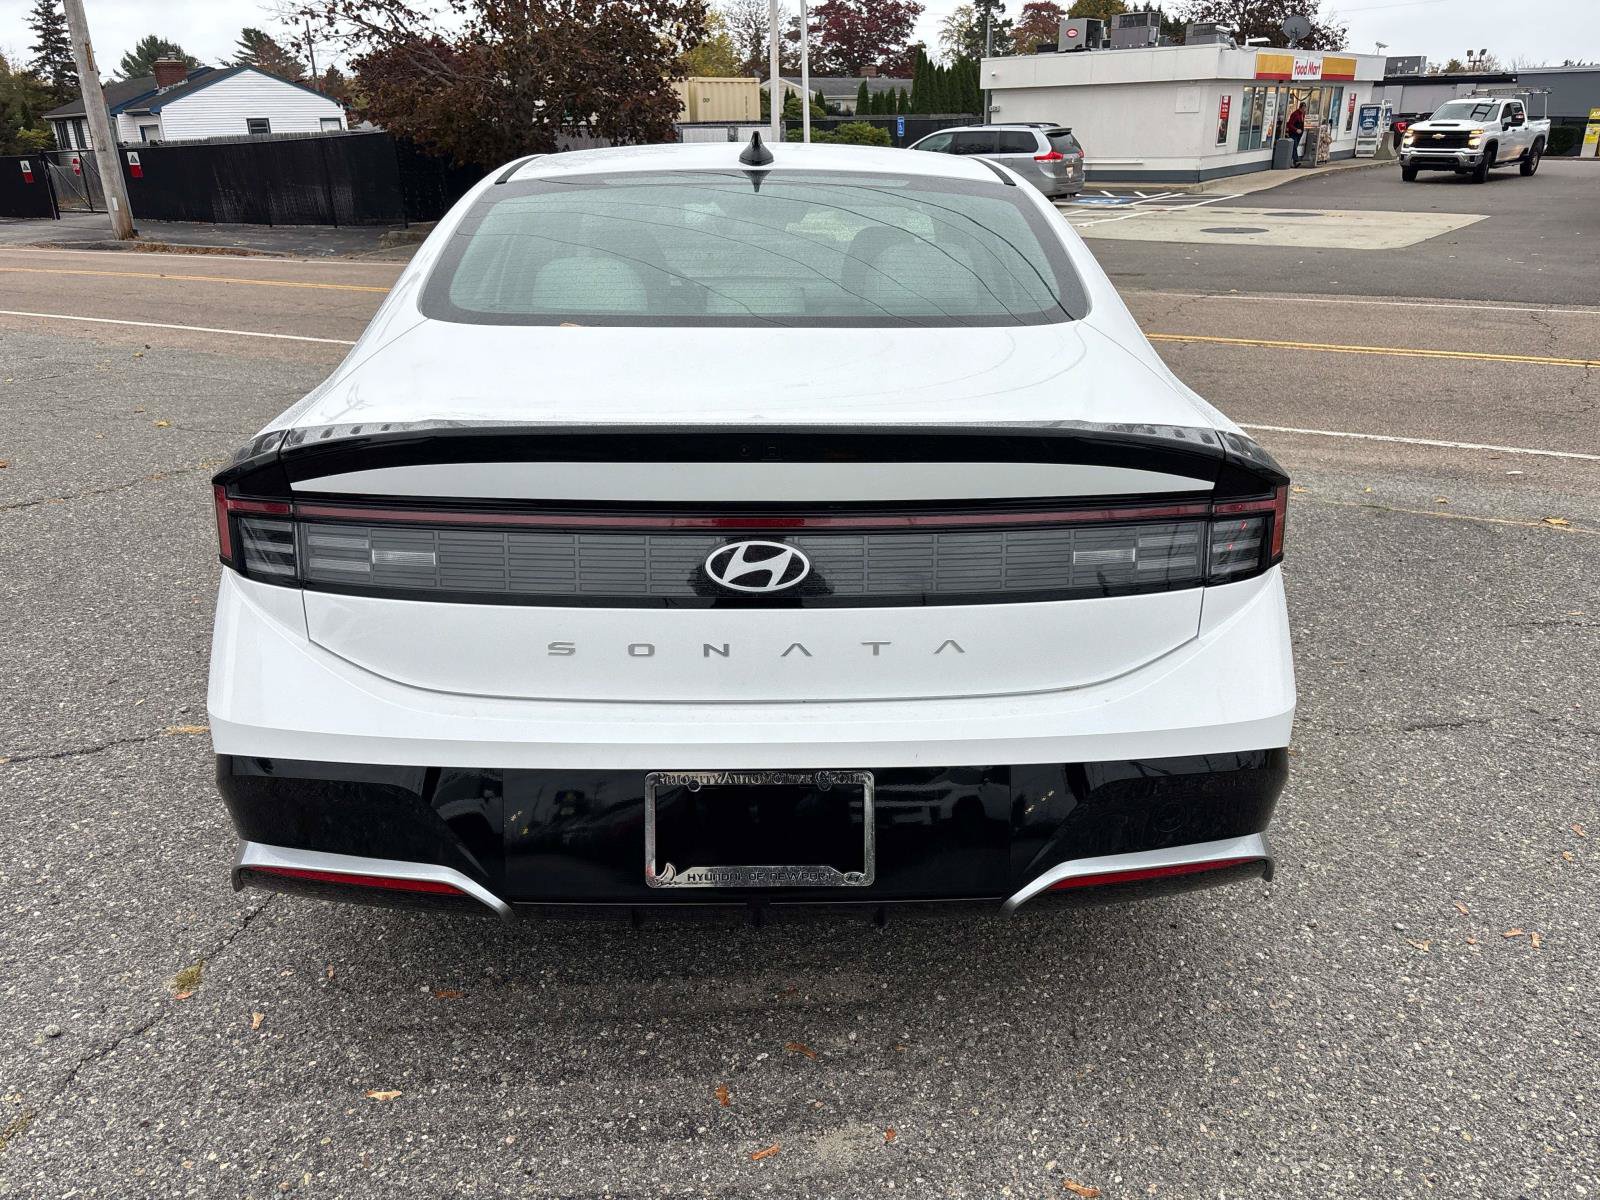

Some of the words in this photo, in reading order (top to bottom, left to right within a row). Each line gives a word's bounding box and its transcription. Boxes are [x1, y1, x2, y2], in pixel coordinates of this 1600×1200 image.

[1295, 59, 1308, 75] Food
[1308, 61, 1321, 75] Mart
[547, 639, 966, 657] SONATA
[687, 873, 742, 882] HYUNDAI
[749, 873, 765, 881] OF
[769, 872, 834, 882] NEWPORT
